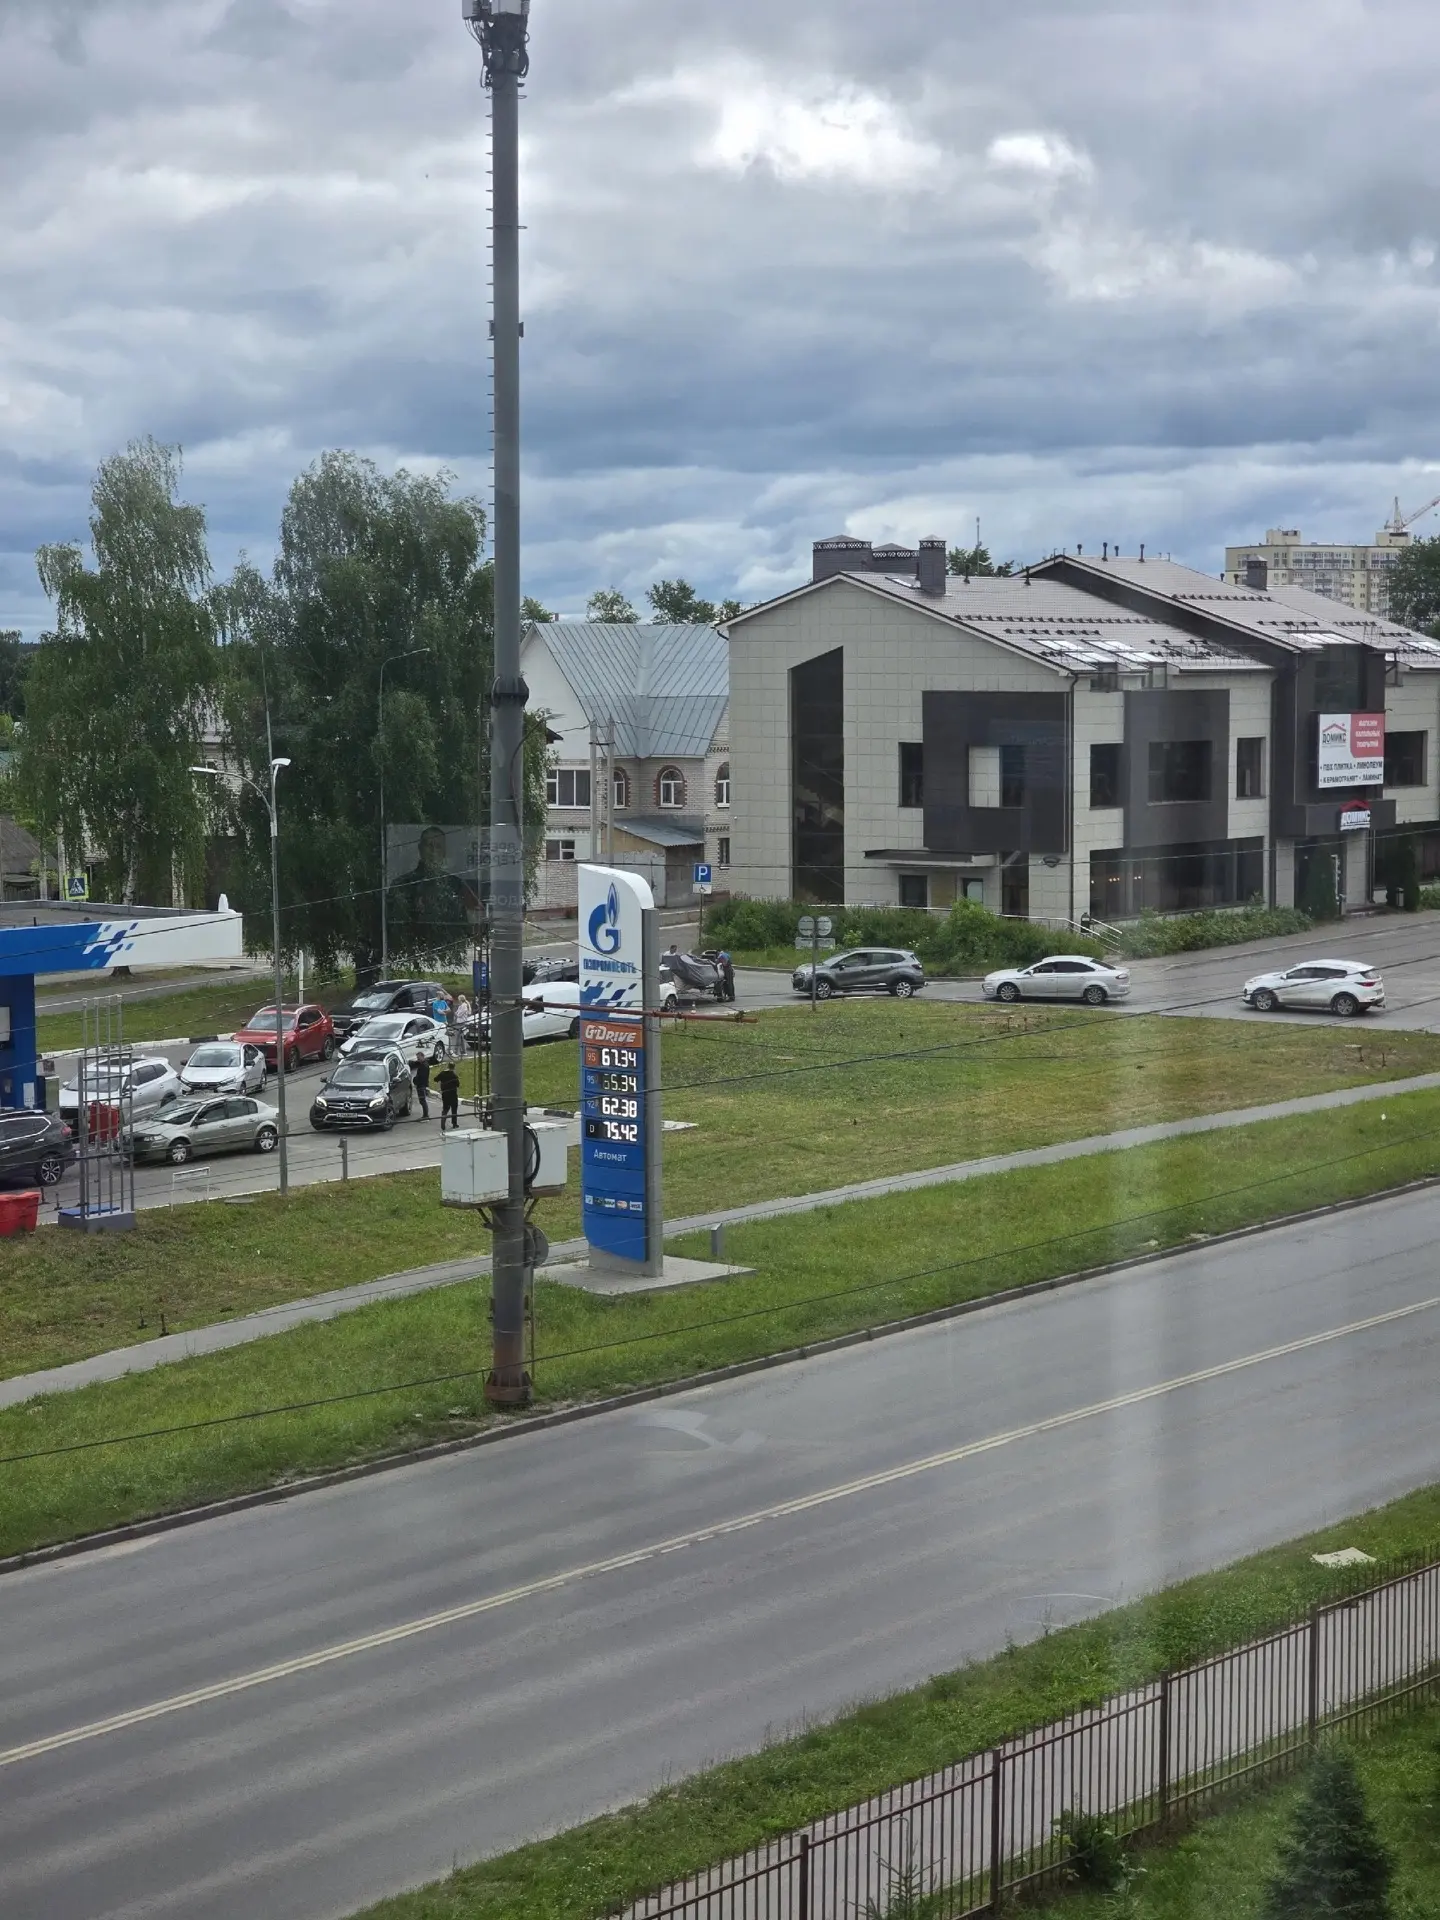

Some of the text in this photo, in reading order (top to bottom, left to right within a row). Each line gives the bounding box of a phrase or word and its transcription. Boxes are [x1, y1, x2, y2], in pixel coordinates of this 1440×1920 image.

[1322, 733, 1347, 744] ДОМИКС
[1334, 762, 1353, 771] ПЛИТКА
[1357, 761, 1383, 769] ЛИНОЛЕУМ
[1322, 775, 1358, 784] КЕРАМОГРАНИТ
[698, 866, 708, 881] P
[587, 1048, 637, 1068] 95 67.34
[586, 1075, 595, 1084] 95
[586, 1097, 638, 1118] 92 62.38
[602, 1121, 637, 1141] 75.42
[593, 1148, 628, 1163] Автомат
